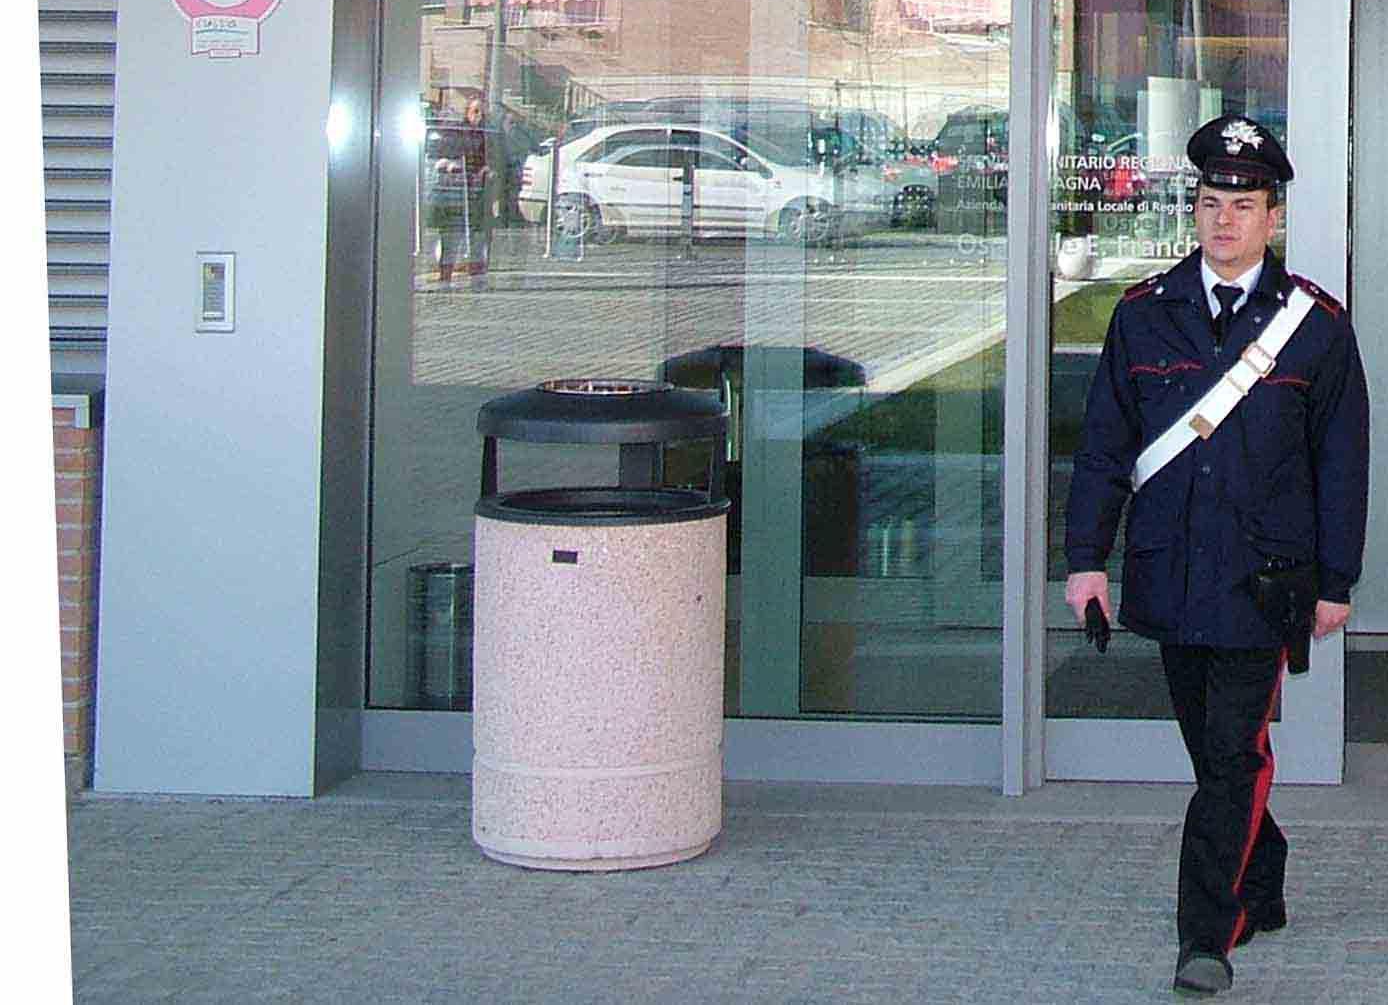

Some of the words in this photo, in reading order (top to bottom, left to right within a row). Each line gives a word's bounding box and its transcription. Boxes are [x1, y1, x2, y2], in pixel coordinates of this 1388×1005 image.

[1054, 155, 1116, 170] NITARIO
[1121, 155, 1197, 170] REGIONA
[1051, 199, 1095, 212] anitaria
[1097, 199, 1135, 212] Locale
[1118, 233, 1202, 257] Franch
